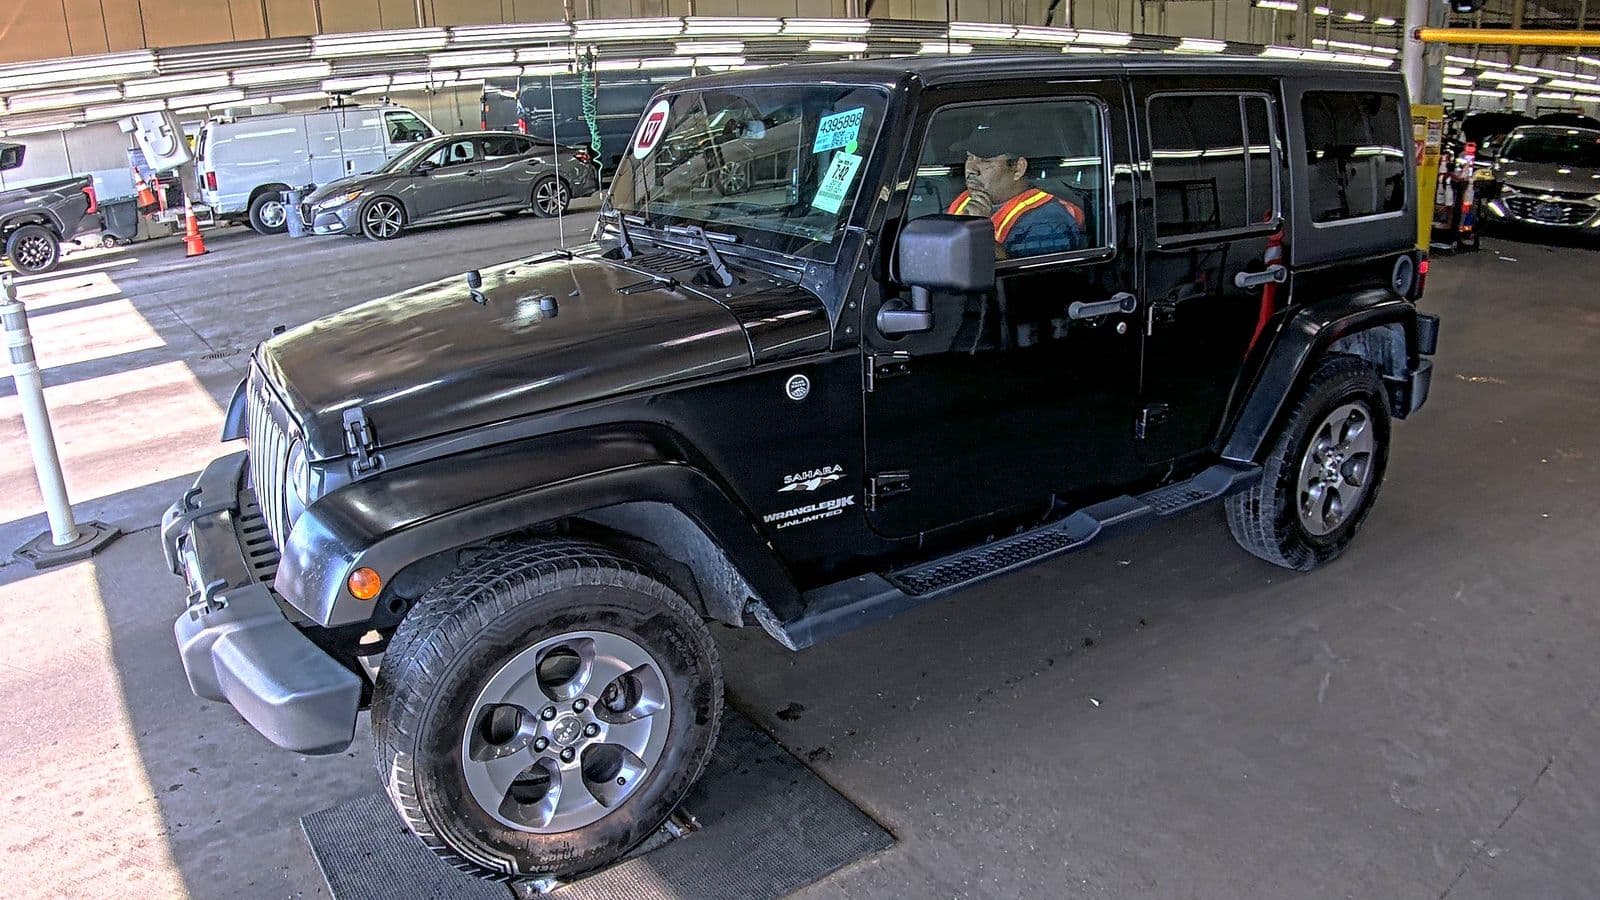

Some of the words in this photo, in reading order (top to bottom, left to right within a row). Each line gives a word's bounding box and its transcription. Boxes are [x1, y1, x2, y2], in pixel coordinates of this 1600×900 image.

[820, 112, 862, 134] 4395898
[783, 464, 843, 484] SAHARA
[777, 509, 843, 529] UNLIMITED
